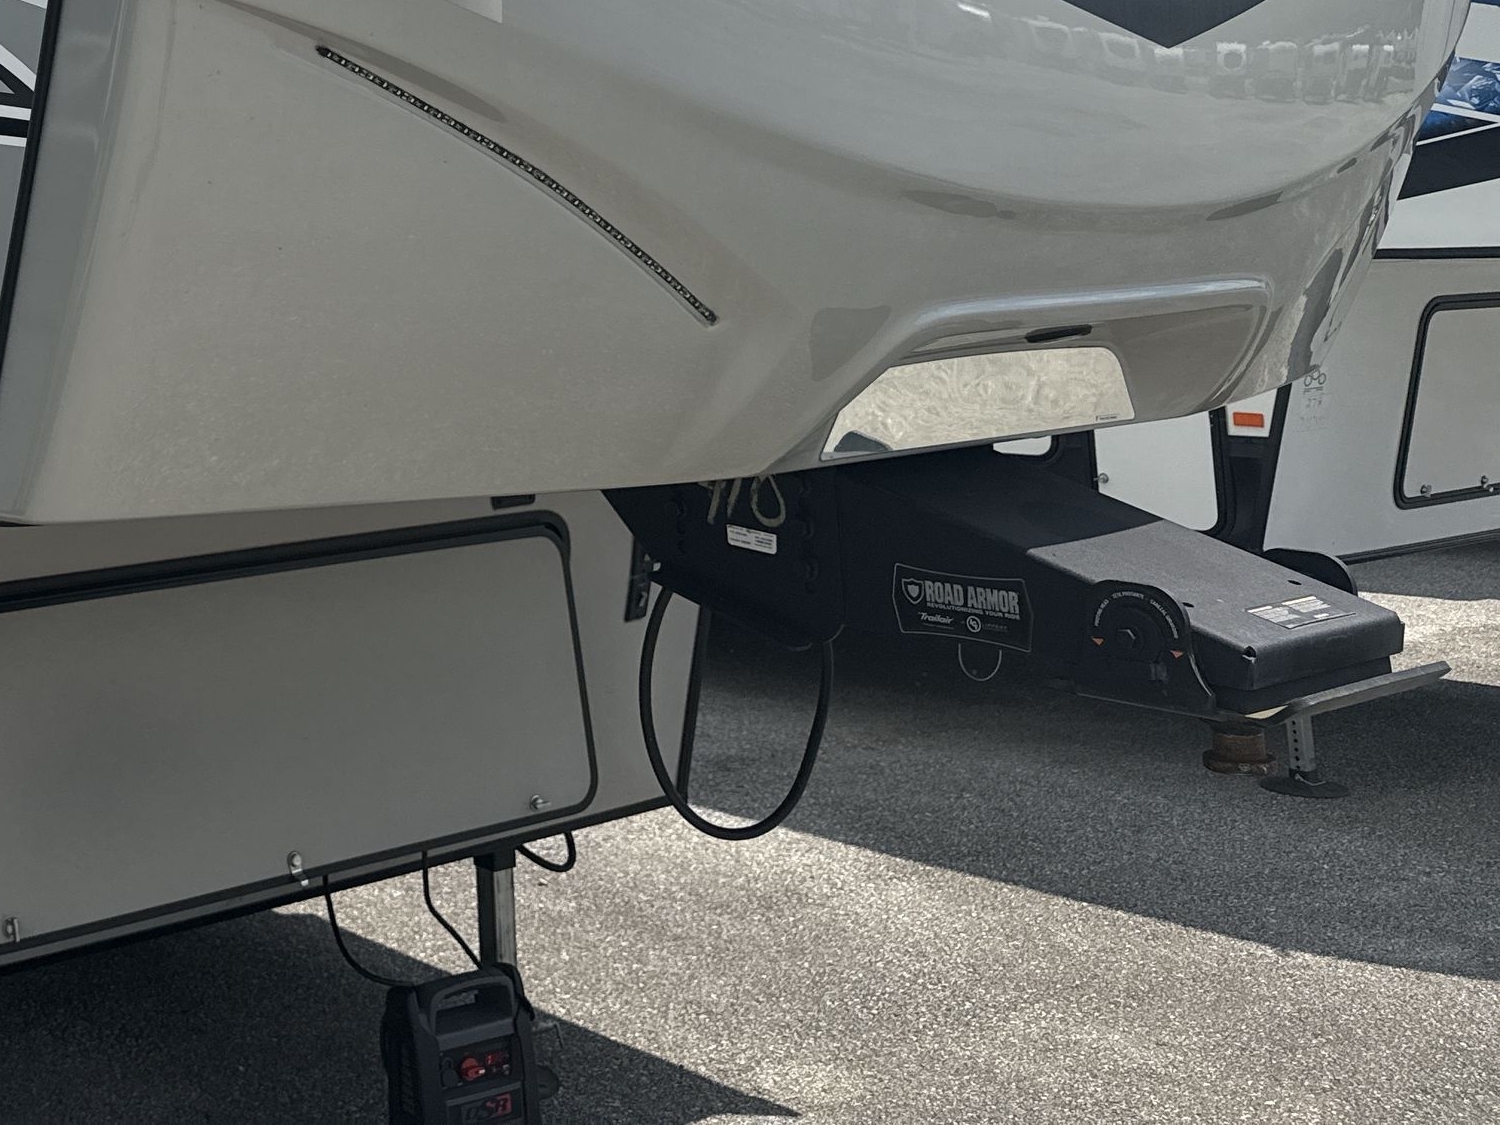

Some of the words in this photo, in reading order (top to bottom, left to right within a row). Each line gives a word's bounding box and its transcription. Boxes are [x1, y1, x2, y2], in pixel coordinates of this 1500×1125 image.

[924, 580, 965, 606] ROAD
[967, 585, 1021, 614] ARMOR
[920, 612, 954, 625] Trailair
